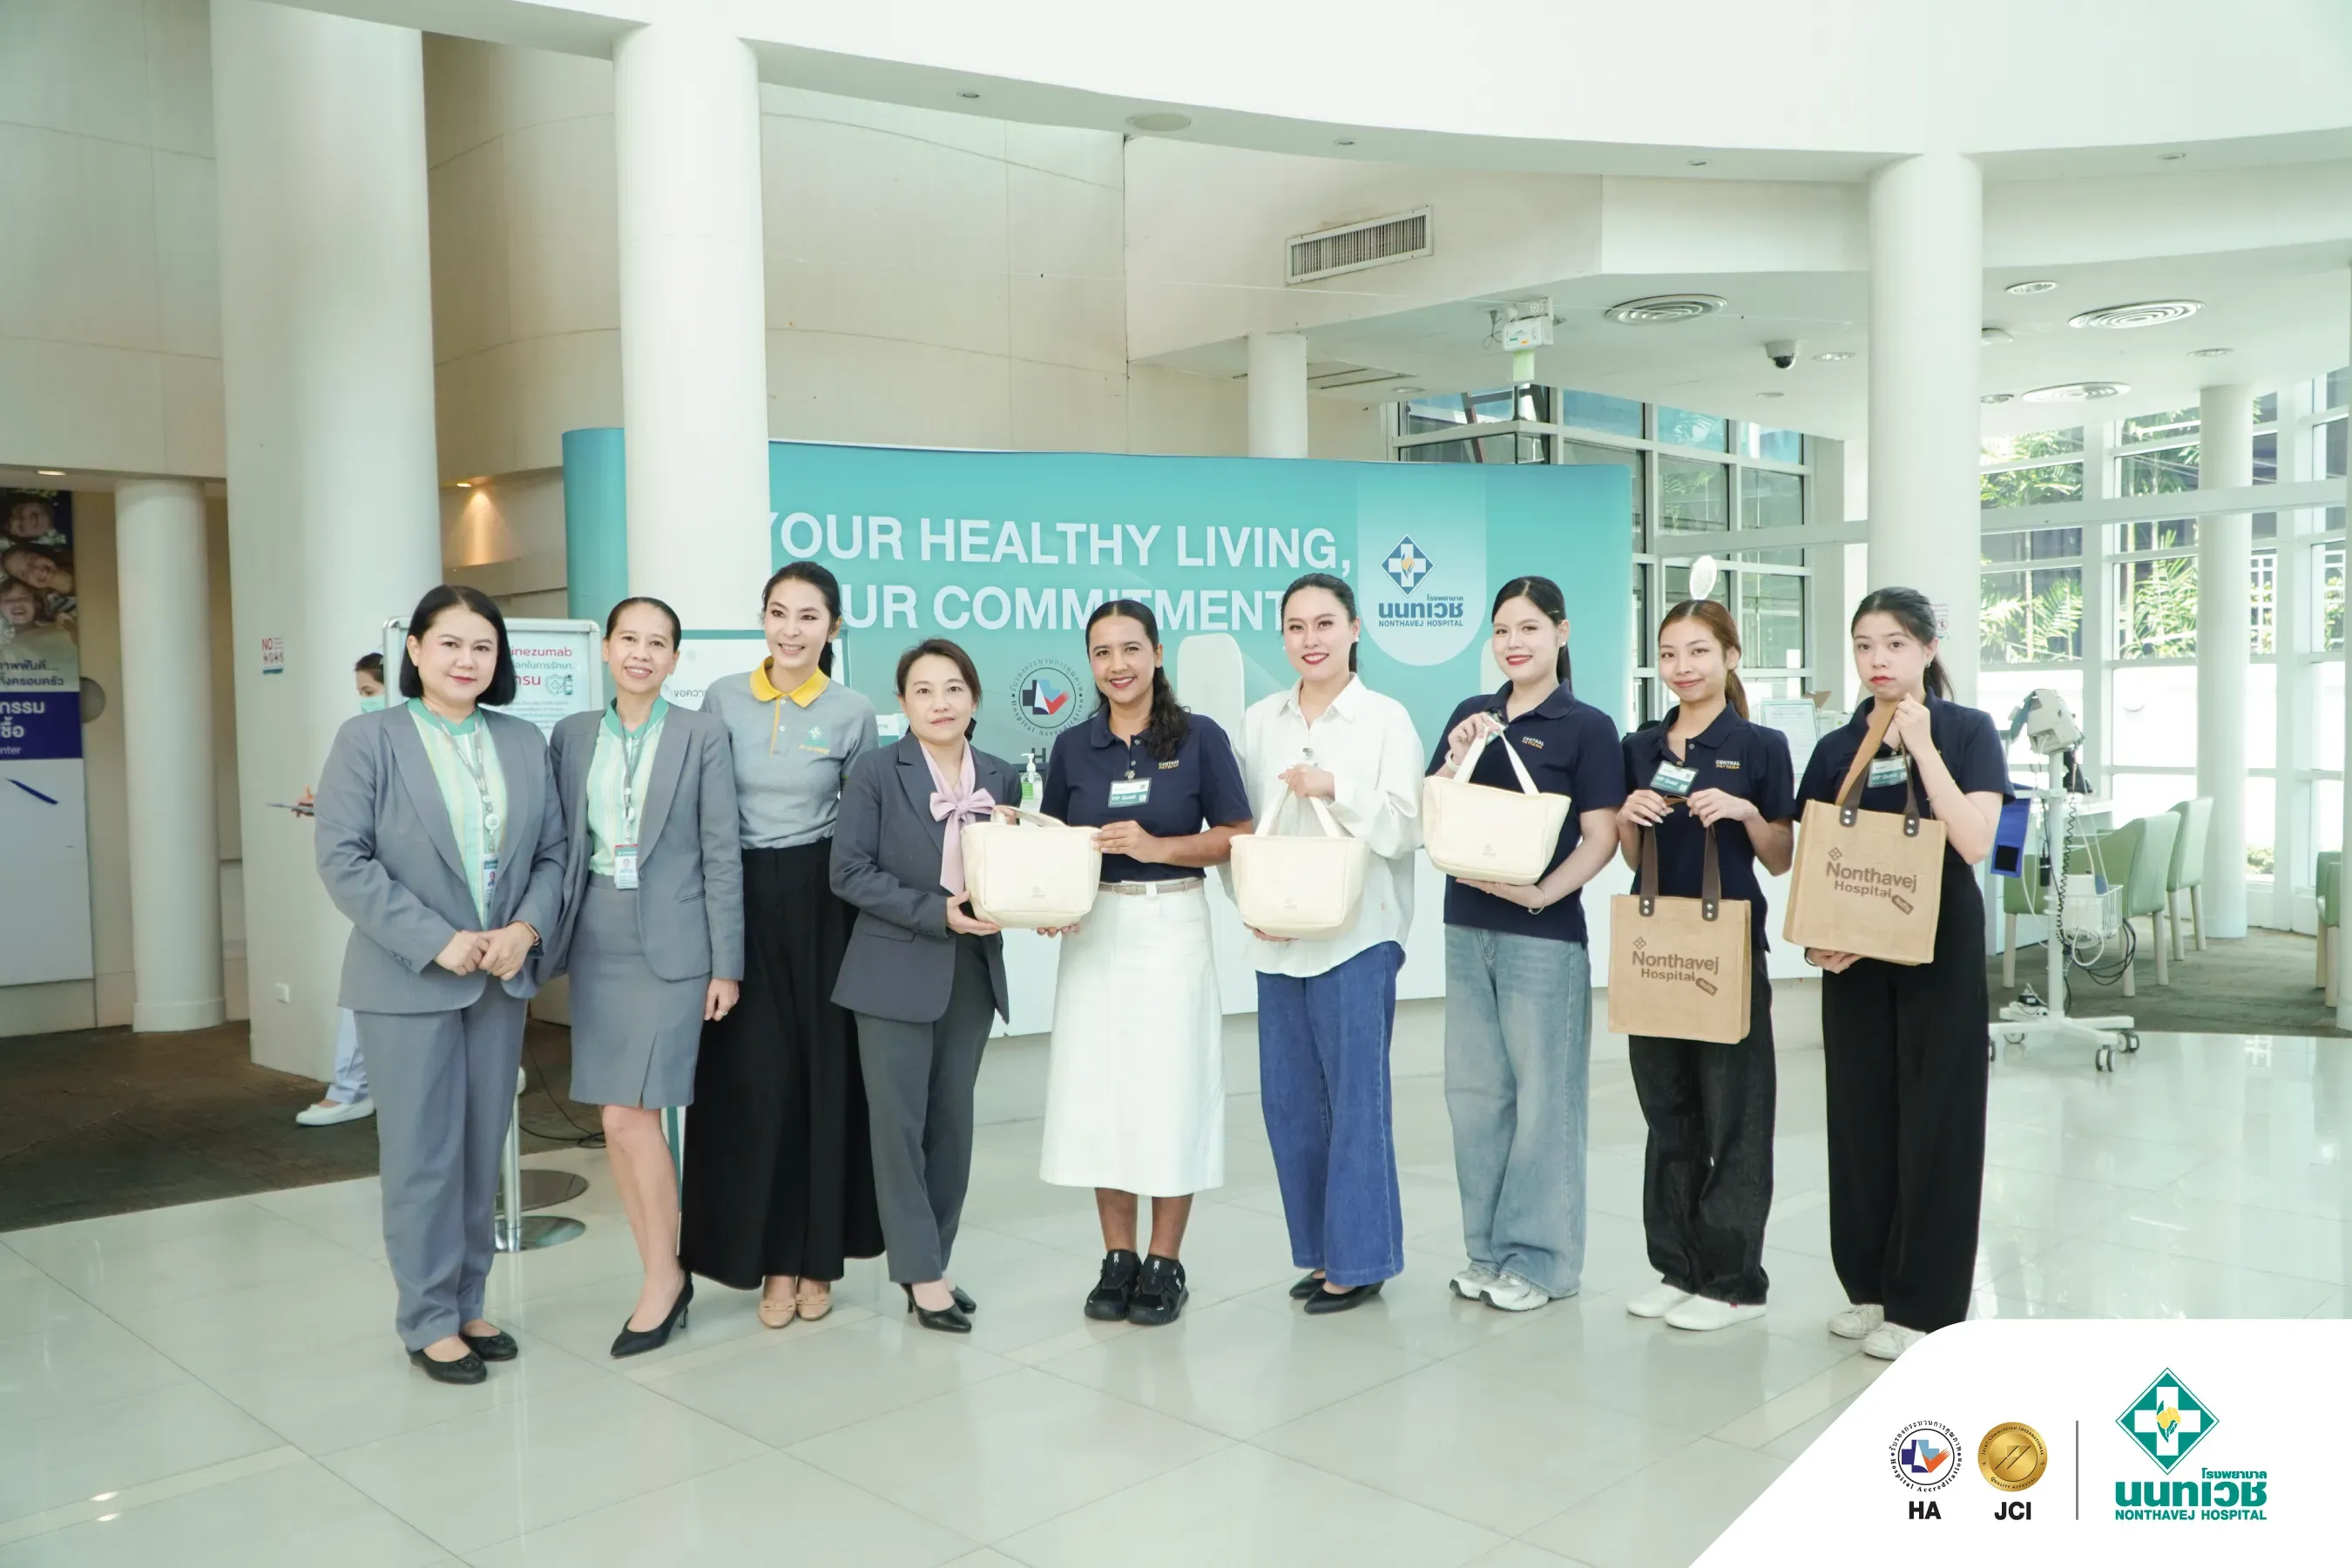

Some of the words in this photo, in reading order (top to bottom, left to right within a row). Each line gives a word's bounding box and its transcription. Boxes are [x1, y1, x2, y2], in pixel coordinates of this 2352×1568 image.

[921, 517, 1161, 565] HEALTHY
[1178, 525, 1350, 577] LIVING,
[841, 585, 919, 629] UR
[934, 585, 1285, 630] COMMTMENT
[1378, 603, 1463, 618] นนทเวช
[511, 645, 572, 657] inezumab
[672, 689, 706, 698] ขอควา
[1522, 736, 1544, 747] CENTRAL
[1825, 861, 1917, 894] Nonthavej
[1834, 880, 1892, 897] Hospital
[1632, 950, 1720, 976] Nonthavej
[1641, 968, 1695, 982] Hospital
